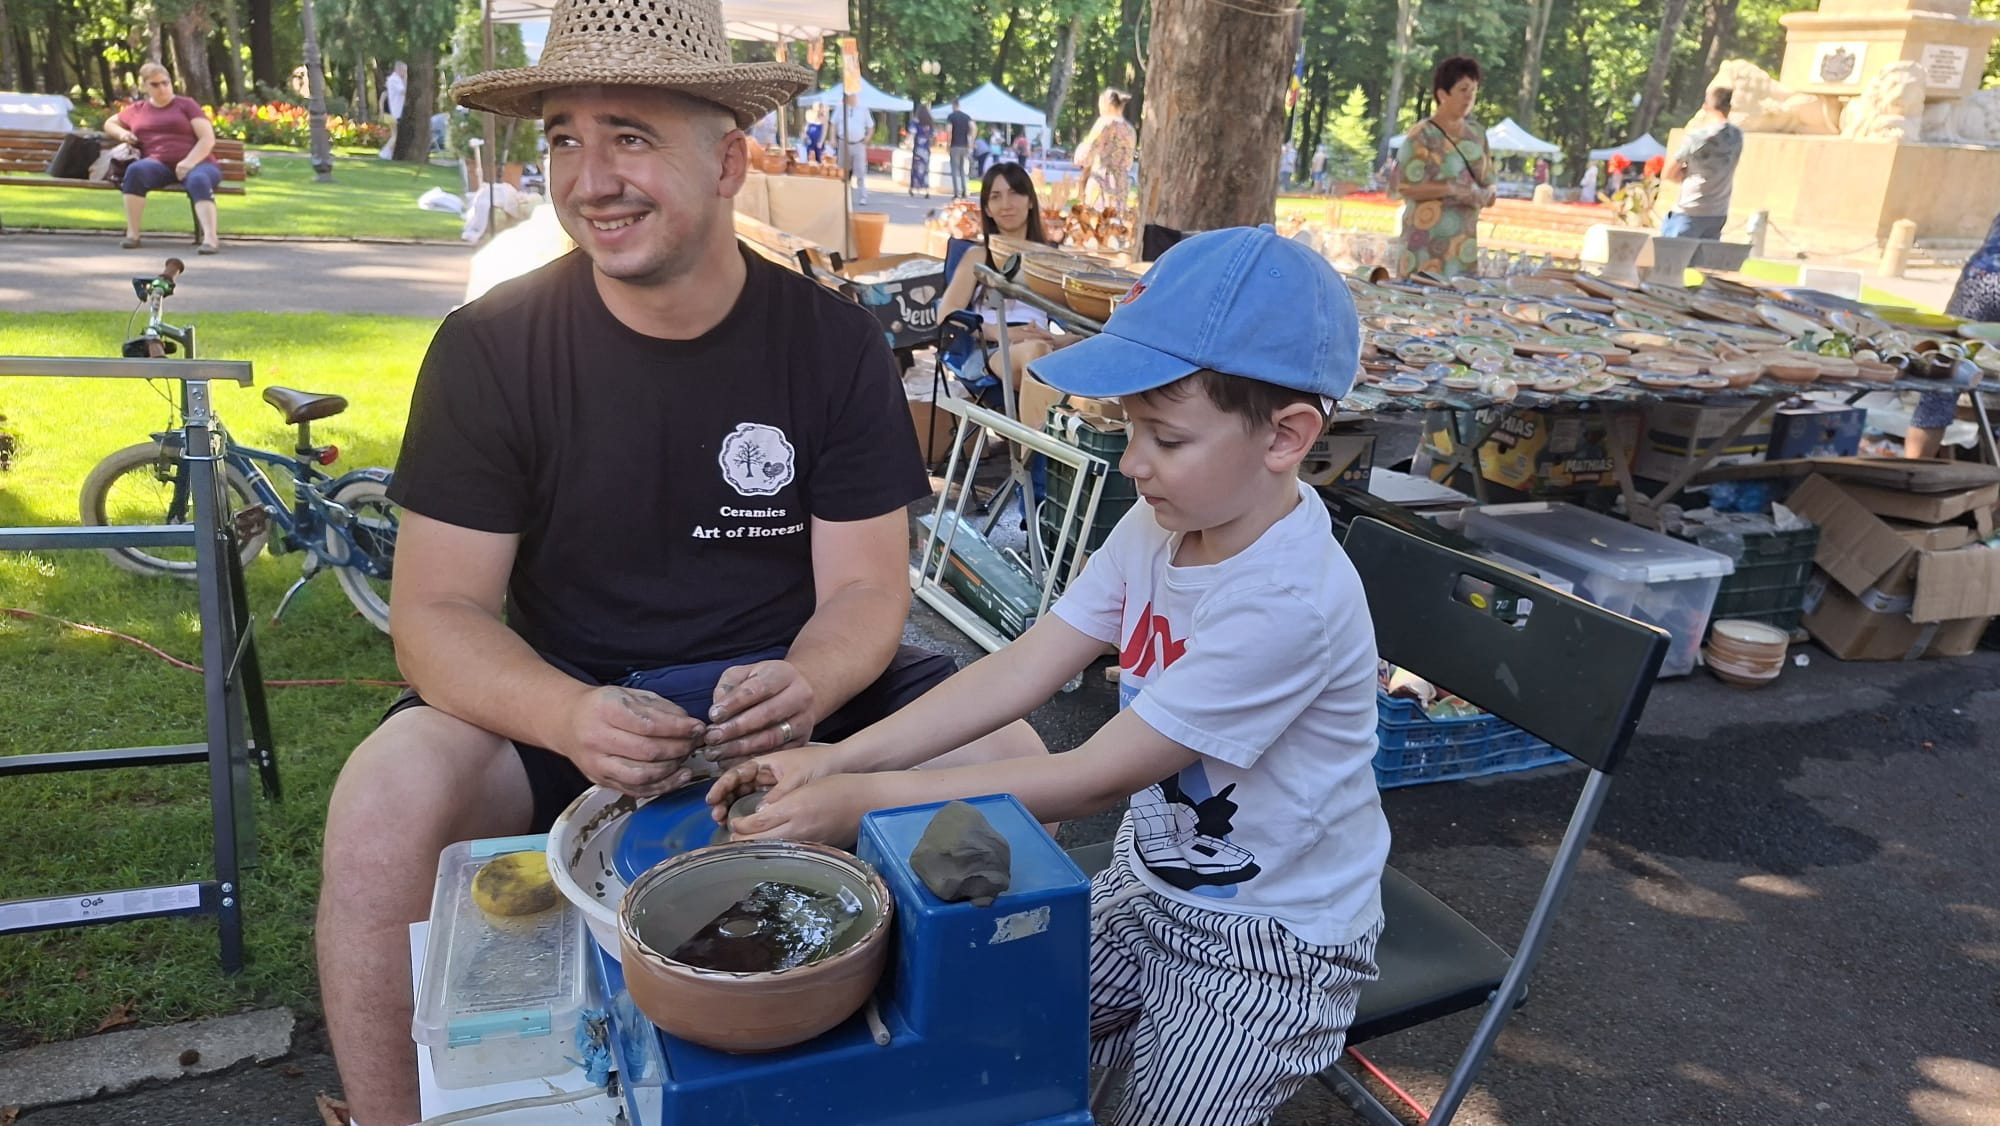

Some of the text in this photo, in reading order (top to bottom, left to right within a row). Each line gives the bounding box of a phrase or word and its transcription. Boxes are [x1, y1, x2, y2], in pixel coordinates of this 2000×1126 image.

[720, 506, 786, 517] Ceramics
[692, 522, 804, 538] Art of Horezu
